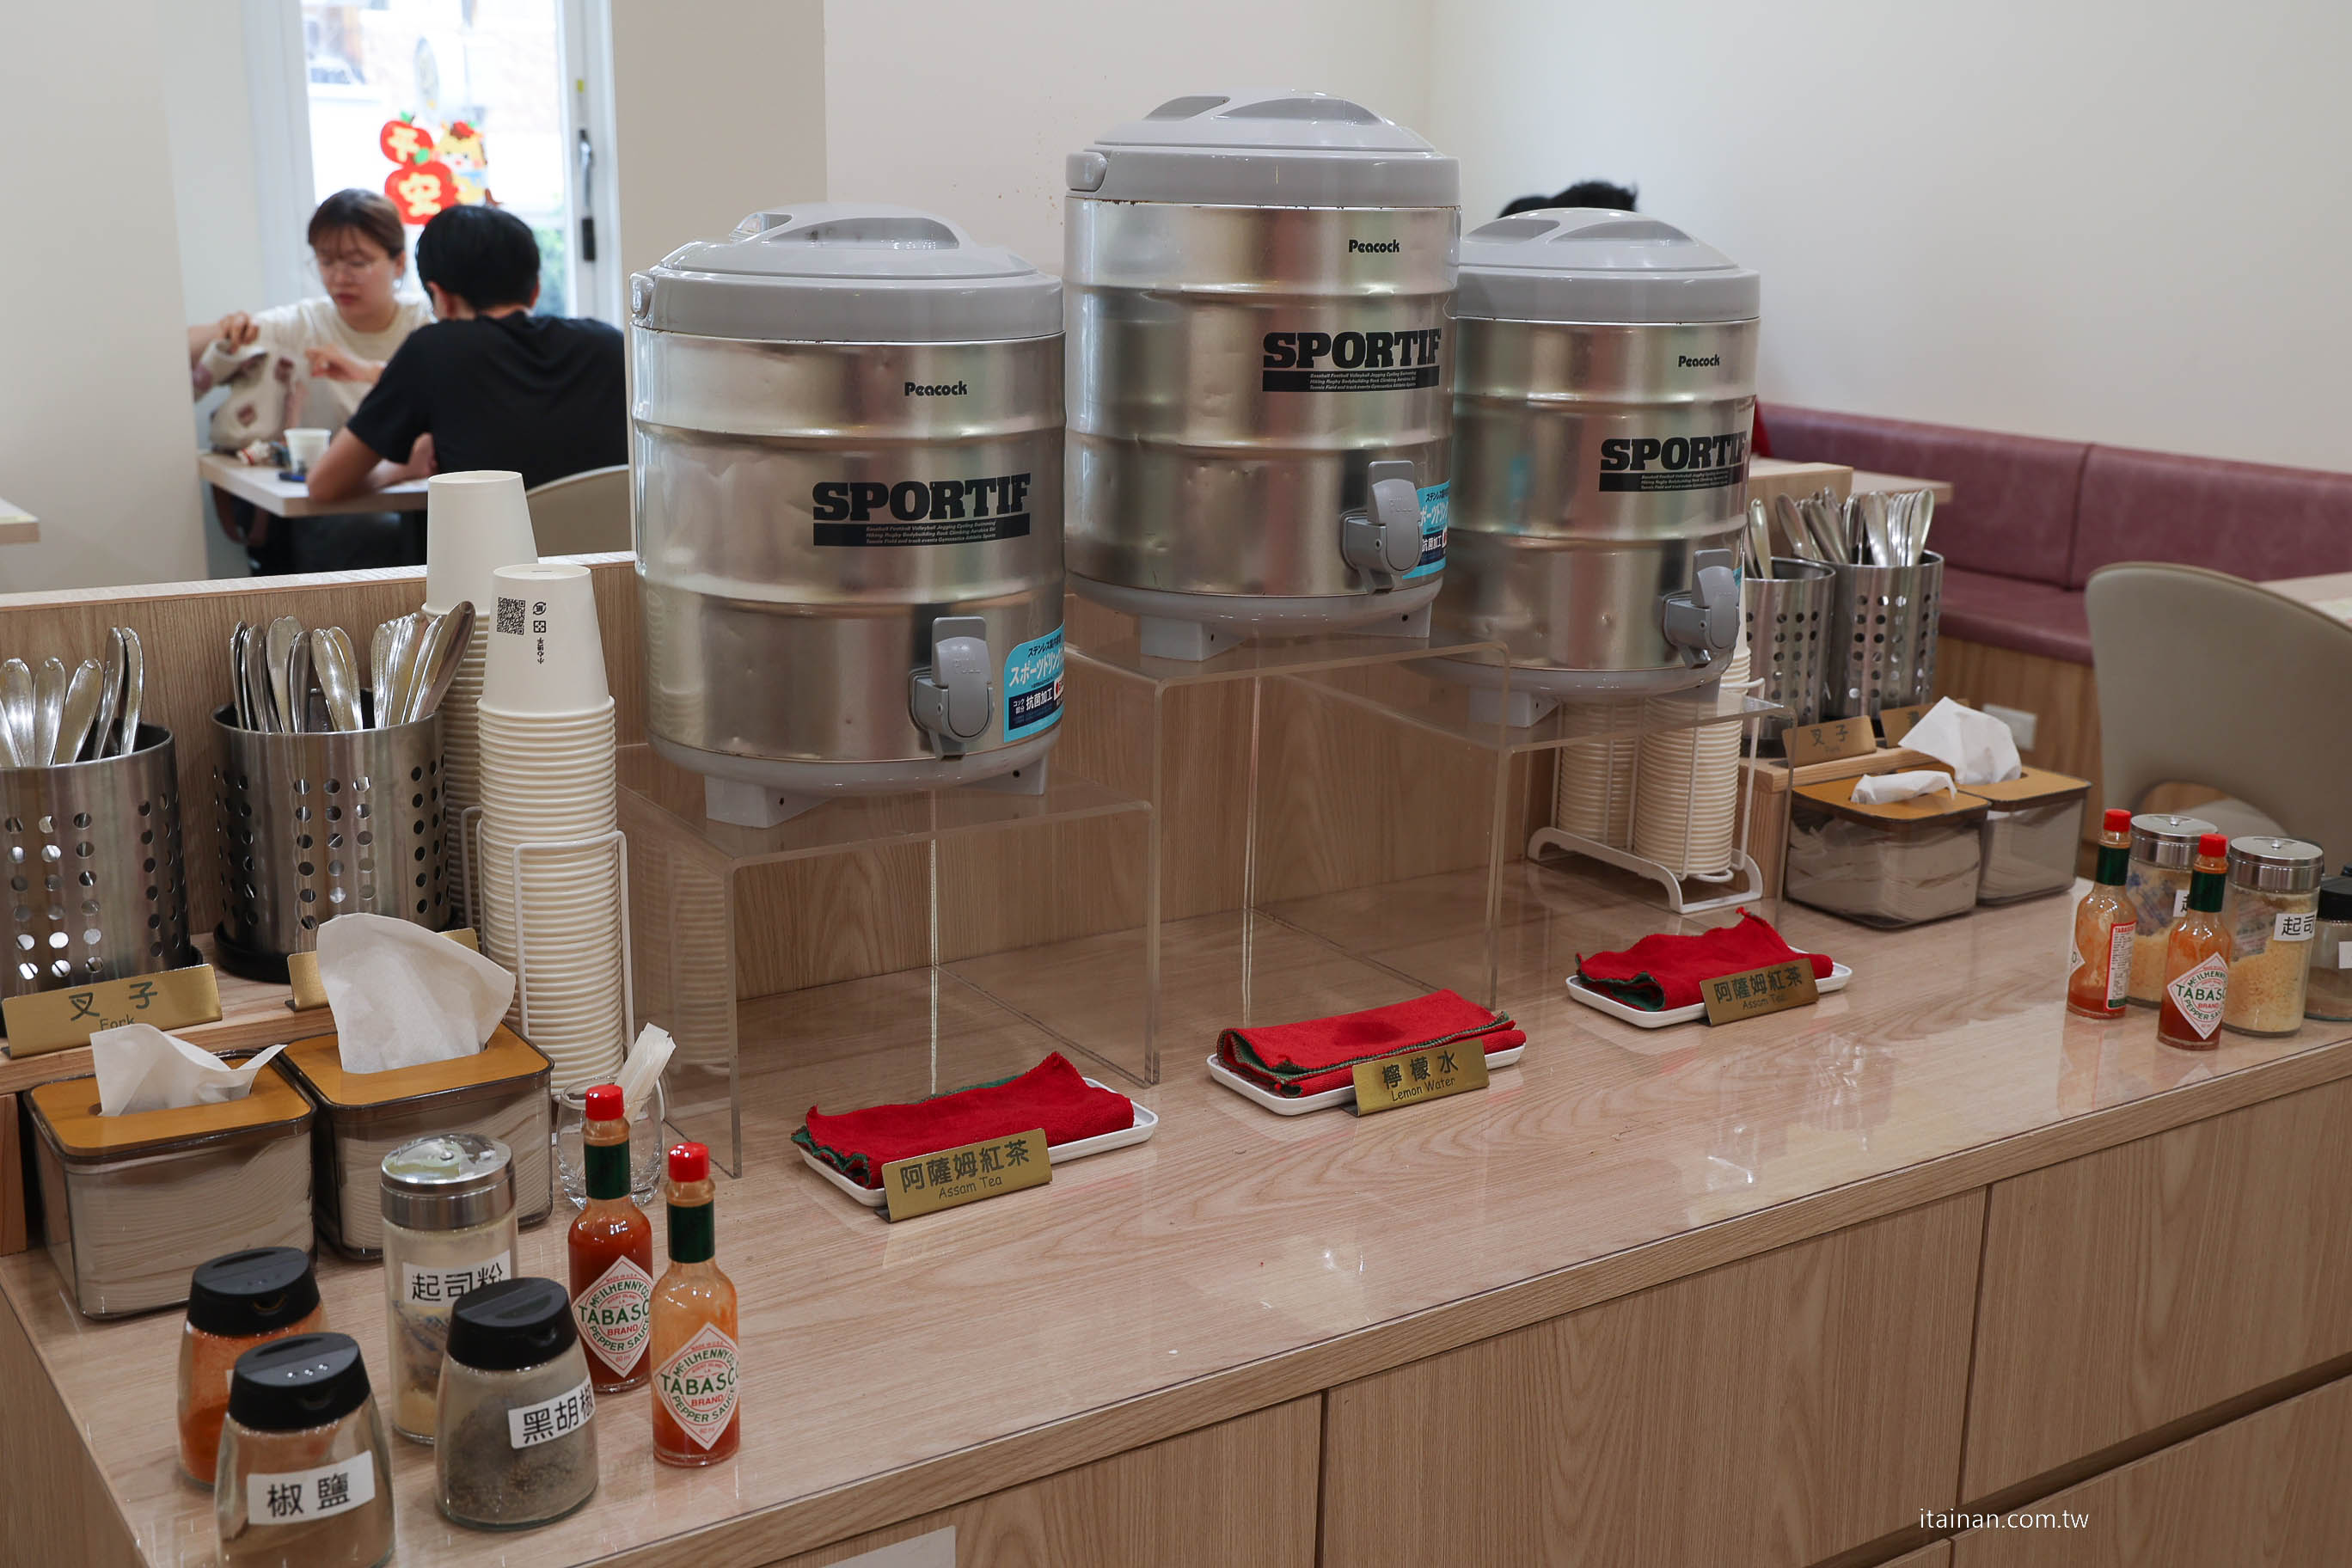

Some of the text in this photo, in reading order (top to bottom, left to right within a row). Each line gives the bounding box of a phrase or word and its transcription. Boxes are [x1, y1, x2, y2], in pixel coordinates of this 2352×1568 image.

[1348, 238, 1400, 254] Peacock
[1263, 328, 1442, 370] SPORTIF
[1678, 353, 1720, 368] Peacock
[904, 380, 968, 396] Peacock
[1601, 430, 1748, 472] SPORTIF
[812, 472, 1032, 522] SPORTIF
[1026, 687, 1053, 712] 抗菌加工
[1713, 965, 1804, 1005] 阿薩姆紅茶
[68, 981, 159, 1022] 叉子
[100, 1013, 137, 1031] Fork
[1381, 1050, 1460, 1091] 檸檬水
[1391, 1076, 1456, 1103] Lemon Water
[900, 1139, 1031, 1194] 阿薩姆紅茶
[938, 1174, 1003, 1200] Assam Tea
[578, 1299, 650, 1326] TABASC
[590, 1325, 625, 1351] PEPPER
[607, 1324, 638, 1337] BRAND
[672, 1394, 709, 1423] PEPPER
[691, 1393, 724, 1407] BRAND
[523, 1383, 594, 1445] 黑胡椒
[267, 1472, 351, 1518] 椒鹽
